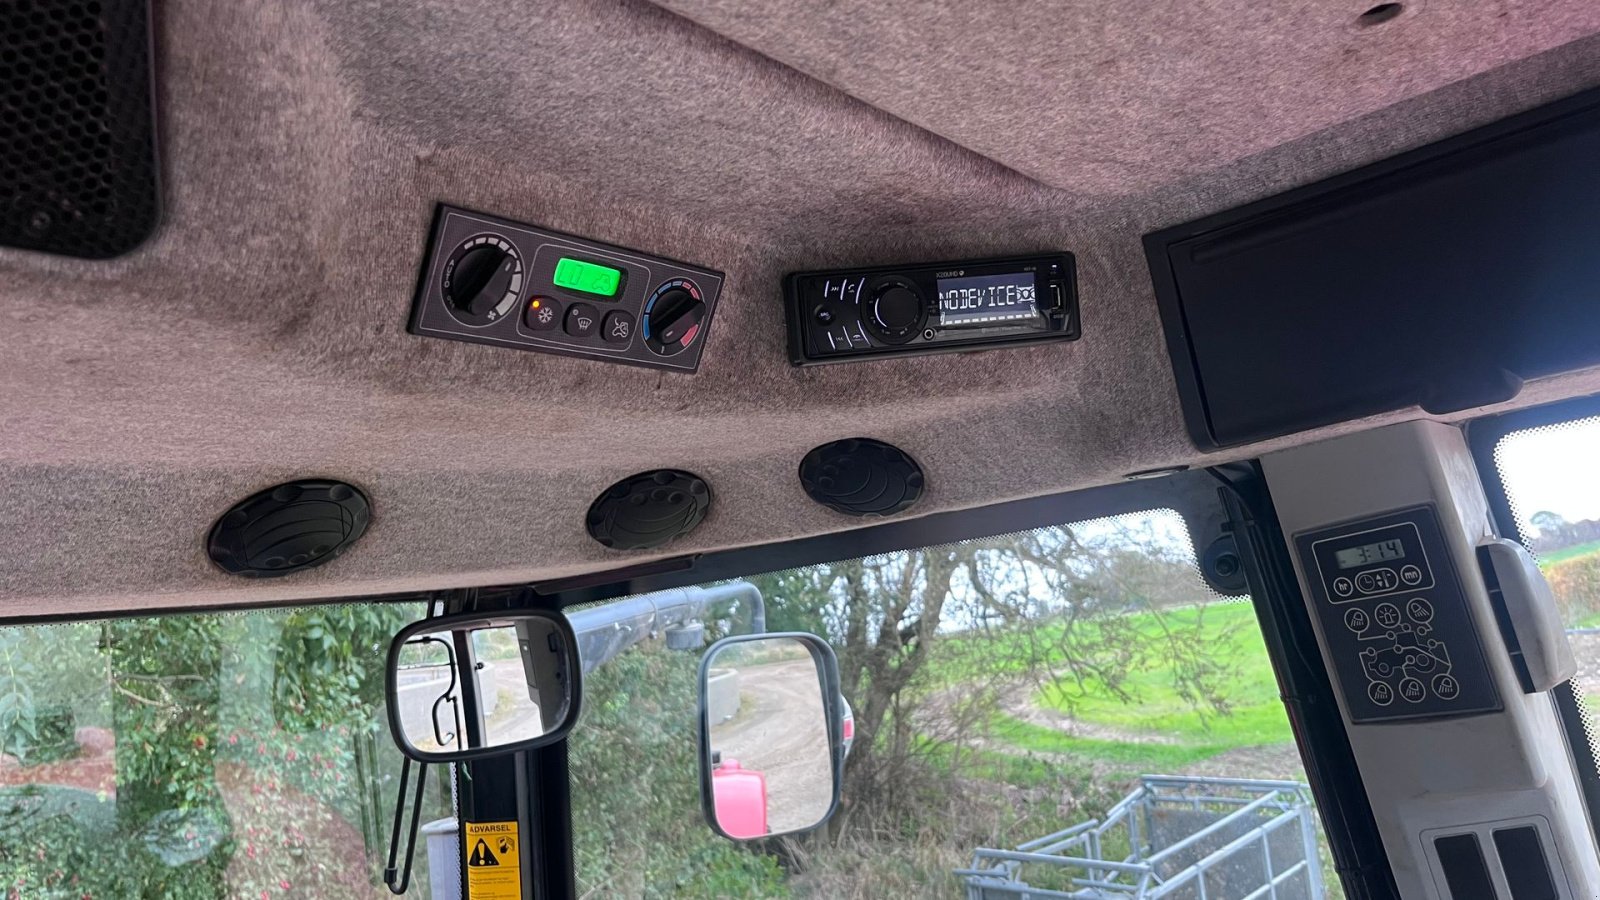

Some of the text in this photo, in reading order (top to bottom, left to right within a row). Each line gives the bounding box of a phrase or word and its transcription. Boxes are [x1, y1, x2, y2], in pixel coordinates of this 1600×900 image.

[444, 259, 455, 288] AUTO
[1356, 541, 1399, 563] 3:14
[1404, 571, 1418, 580] mn
[1338, 582, 1348, 591] hr
[469, 824, 511, 833] ADVARSEL
